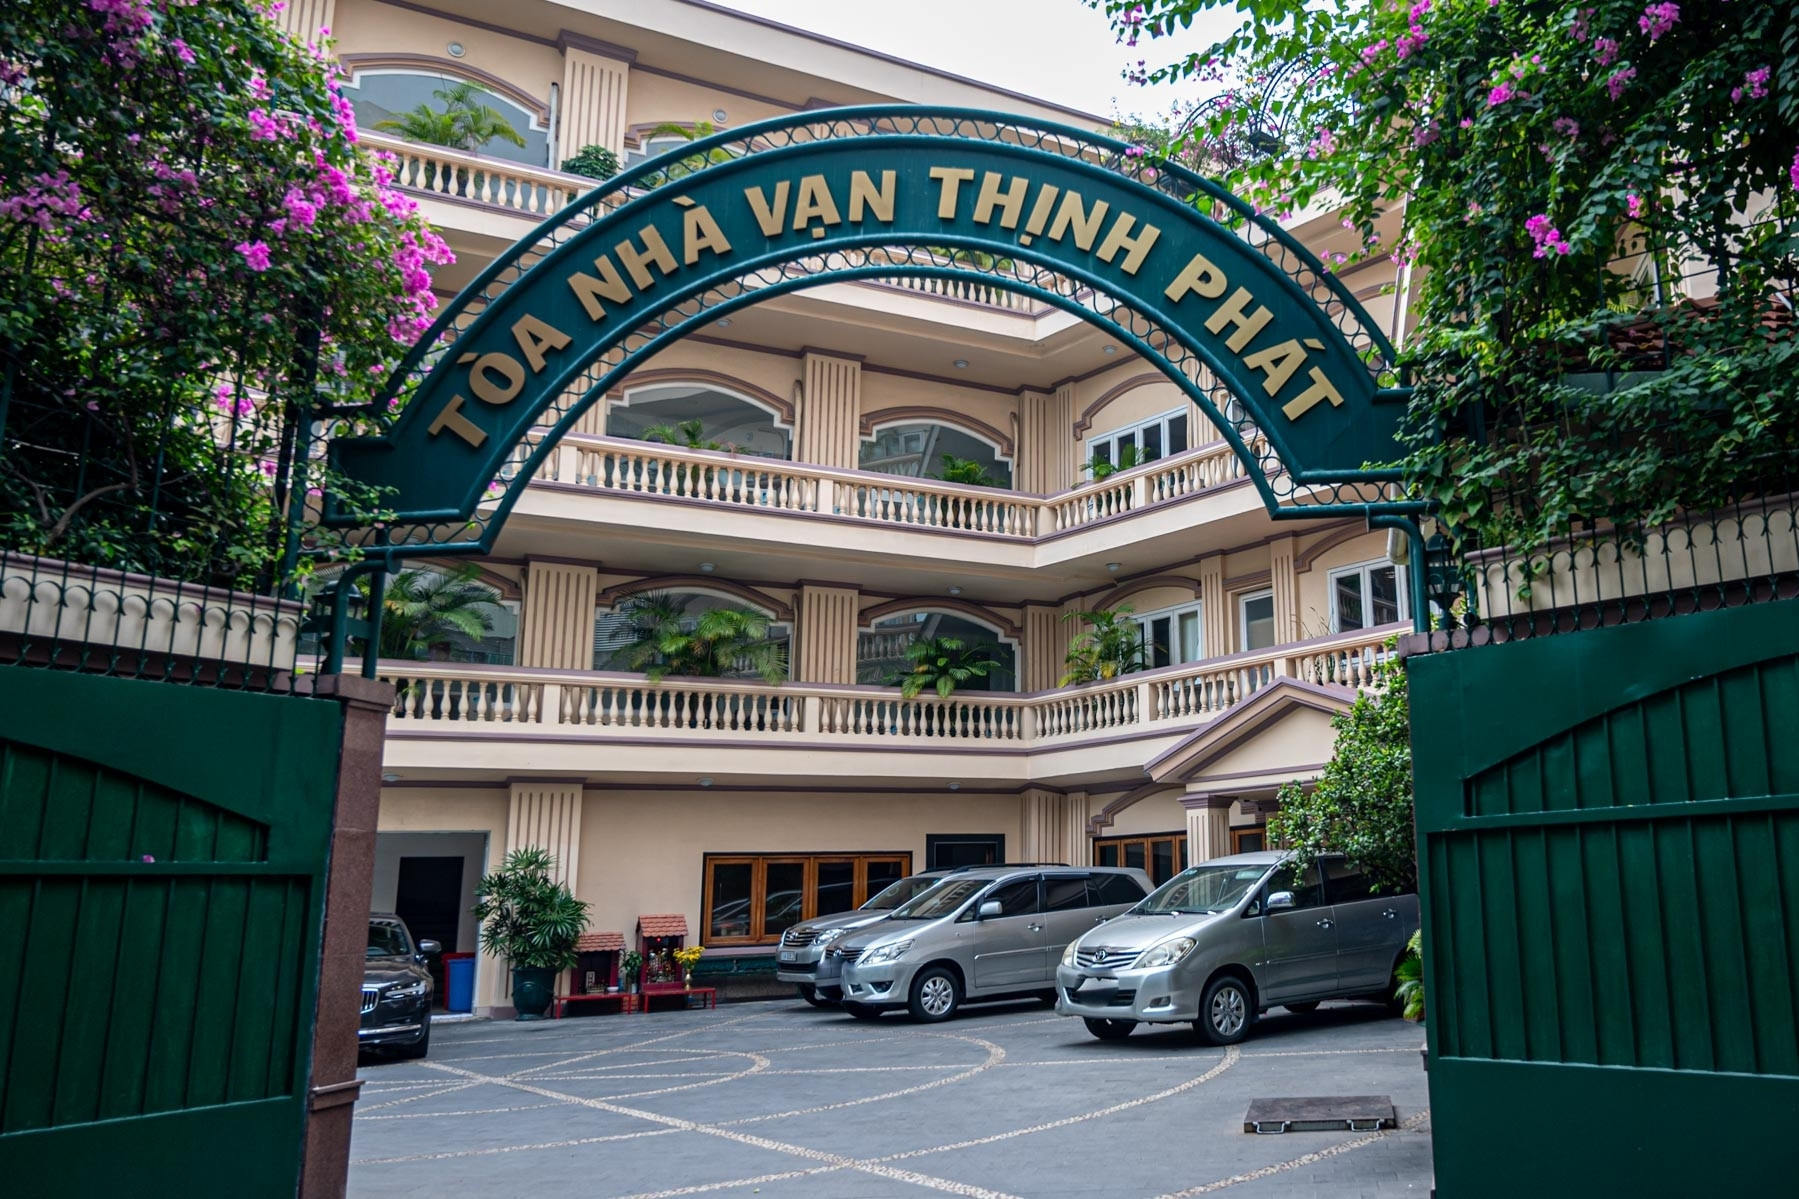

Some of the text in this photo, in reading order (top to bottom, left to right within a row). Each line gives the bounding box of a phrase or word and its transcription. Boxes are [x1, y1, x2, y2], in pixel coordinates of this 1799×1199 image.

[428, 167, 1343, 448] TÒA NHÀ VẠN THỊNH PHÁT
